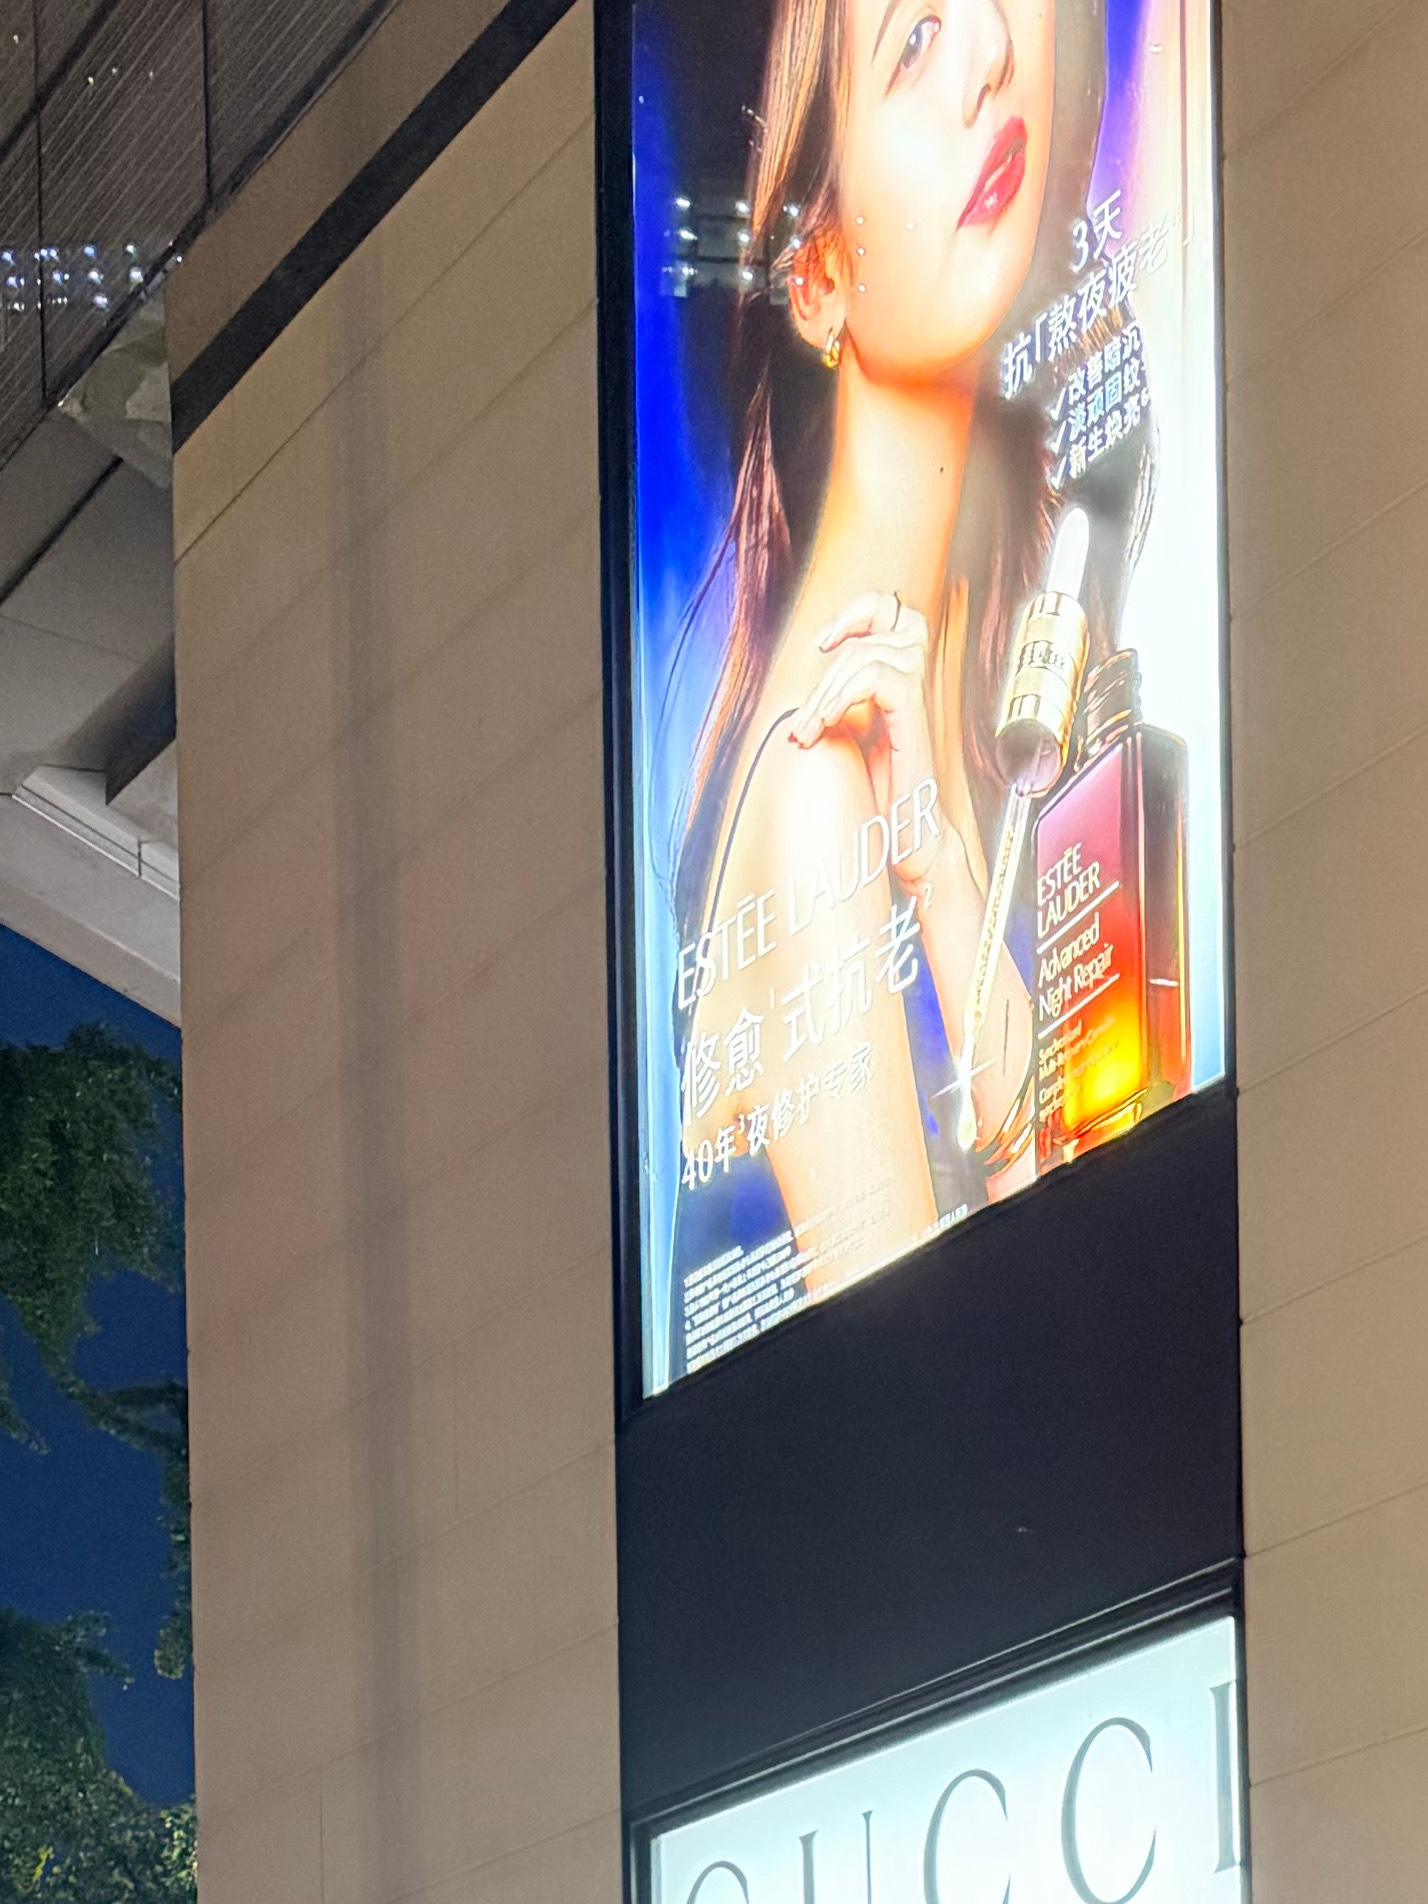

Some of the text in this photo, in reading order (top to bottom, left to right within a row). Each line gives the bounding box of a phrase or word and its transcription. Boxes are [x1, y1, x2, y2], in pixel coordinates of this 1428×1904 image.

[1069, 189, 1122, 273] 3天
[787, 778, 940, 937] LAUDER
[1036, 861, 1101, 939] LAUDER
[1038, 912, 1100, 989] Advanced
[1038, 944, 1115, 1021] Night Repair
